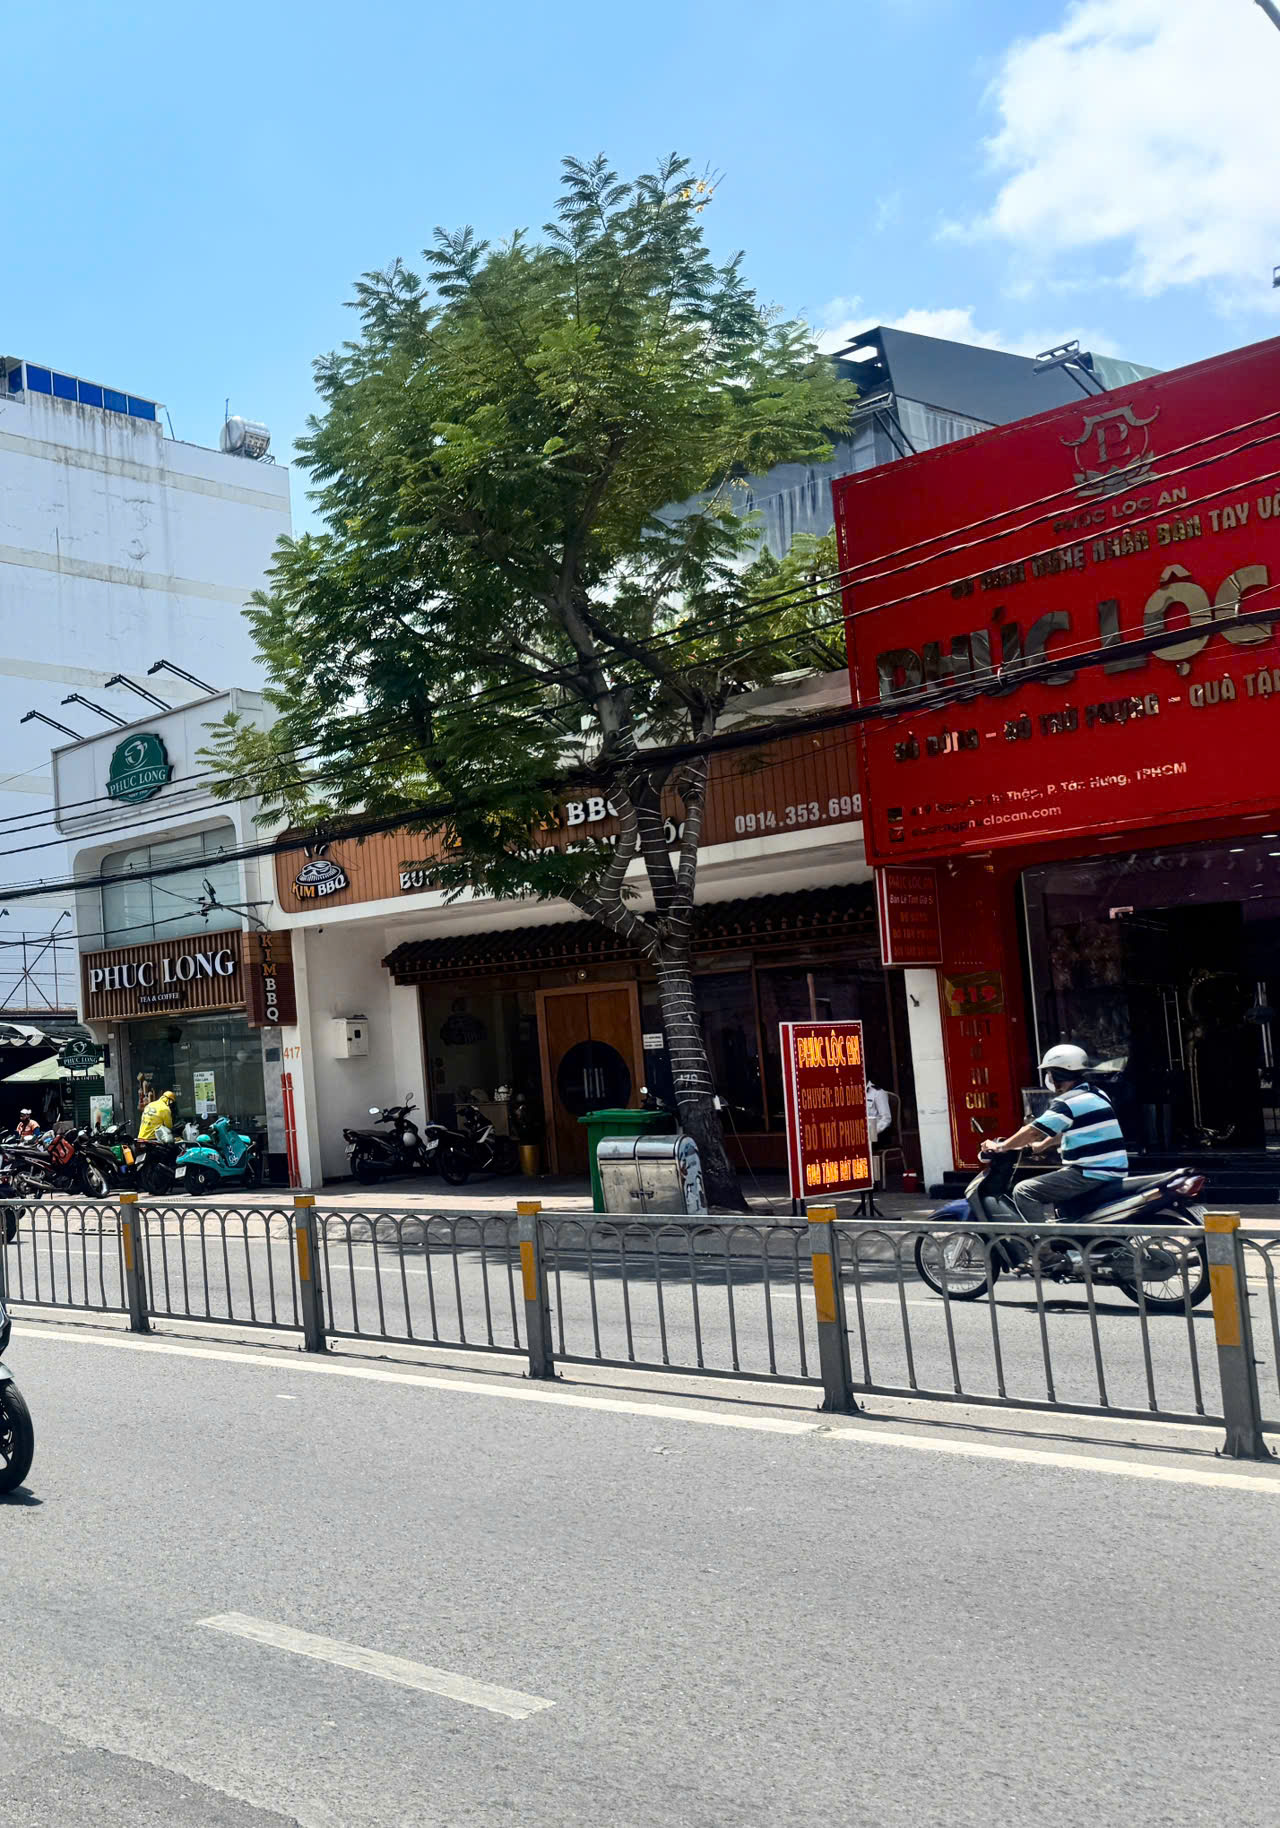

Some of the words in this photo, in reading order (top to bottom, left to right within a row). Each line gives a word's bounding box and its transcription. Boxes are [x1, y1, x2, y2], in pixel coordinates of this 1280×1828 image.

[1158, 486, 1187, 506] AN
[1208, 502, 1249, 532] TAY
[1098, 564, 1272, 676] LỘC
[1189, 672, 1236, 707] QUÀ
[139, 769, 166, 784] LONG
[1047, 784, 1058, 795] P.
[1136, 761, 1187, 780] TPHCM
[735, 793, 862, 834] 0914.353.698
[291, 882, 315, 900] KIM
[317, 874, 347, 896] BBQ
[89, 961, 154, 993] PHUC
[163, 949, 235, 983] LONG
[262, 934, 277, 976] KIM
[265, 978, 279, 1023] BBQ
[283, 1046, 301, 1059] 417
[797, 1030, 826, 1068] PHÚC
[825, 1029, 847, 1073] LỘC
